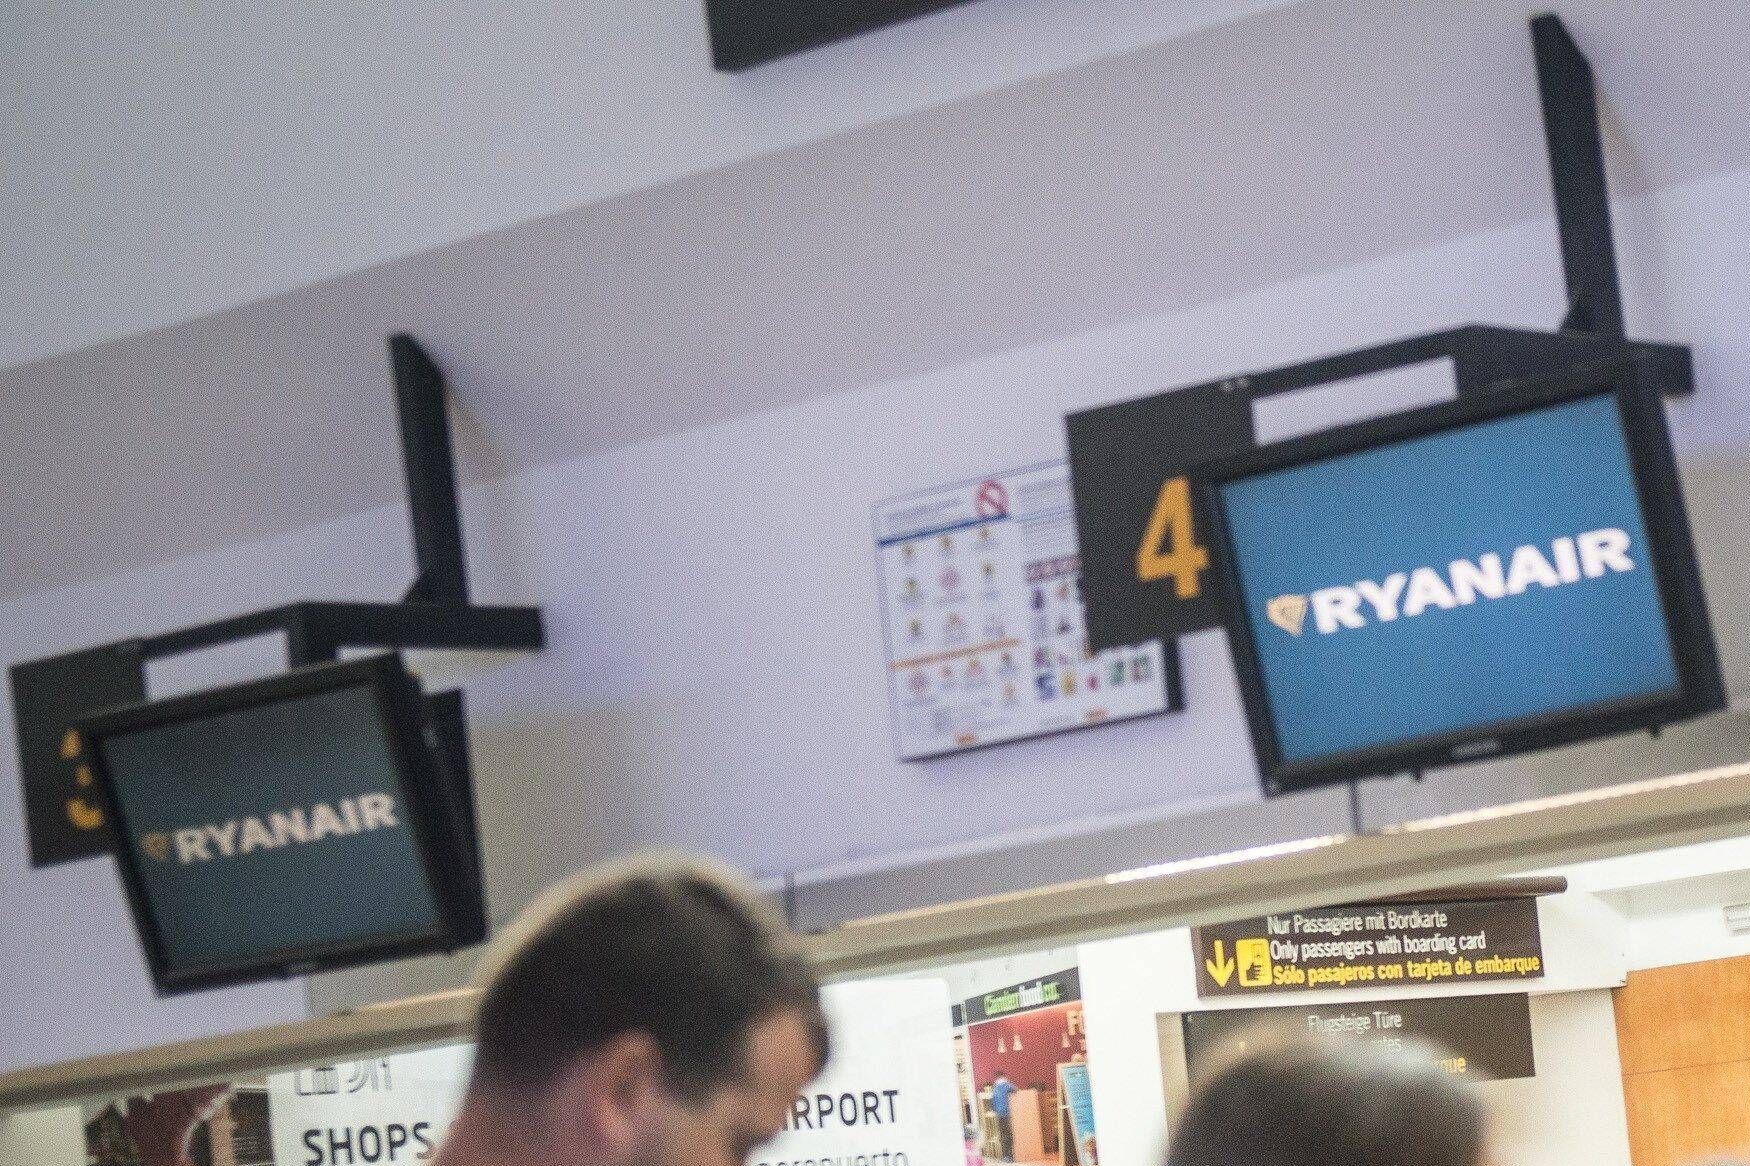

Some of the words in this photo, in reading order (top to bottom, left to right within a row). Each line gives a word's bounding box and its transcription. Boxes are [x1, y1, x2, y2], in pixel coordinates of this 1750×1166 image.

[1136, 475, 1210, 600] 4
[1311, 527, 1636, 635] RYANAIR
[173, 792, 400, 865] RYANAIR
[1267, 915, 1291, 936] Nur
[1294, 913, 1363, 936] Passagiere
[1365, 911, 1386, 931] mit
[1387, 909, 1448, 930] Bordkarte
[1270, 940, 1299, 963] Only
[1301, 939, 1375, 962] passengers
[1375, 934, 1402, 955] with
[1403, 932, 1457, 955] boarding
[1459, 929, 1487, 950] card
[1273, 964, 1305, 985] Sólo
[1308, 962, 1375, 987] pasajeros
[1377, 963, 1403, 980] con
[1406, 957, 1453, 981] tarjeta
[1454, 955, 1472, 976] de
[1475, 954, 1541, 976] embarque
[788, 1089, 900, 1132] RPORT
